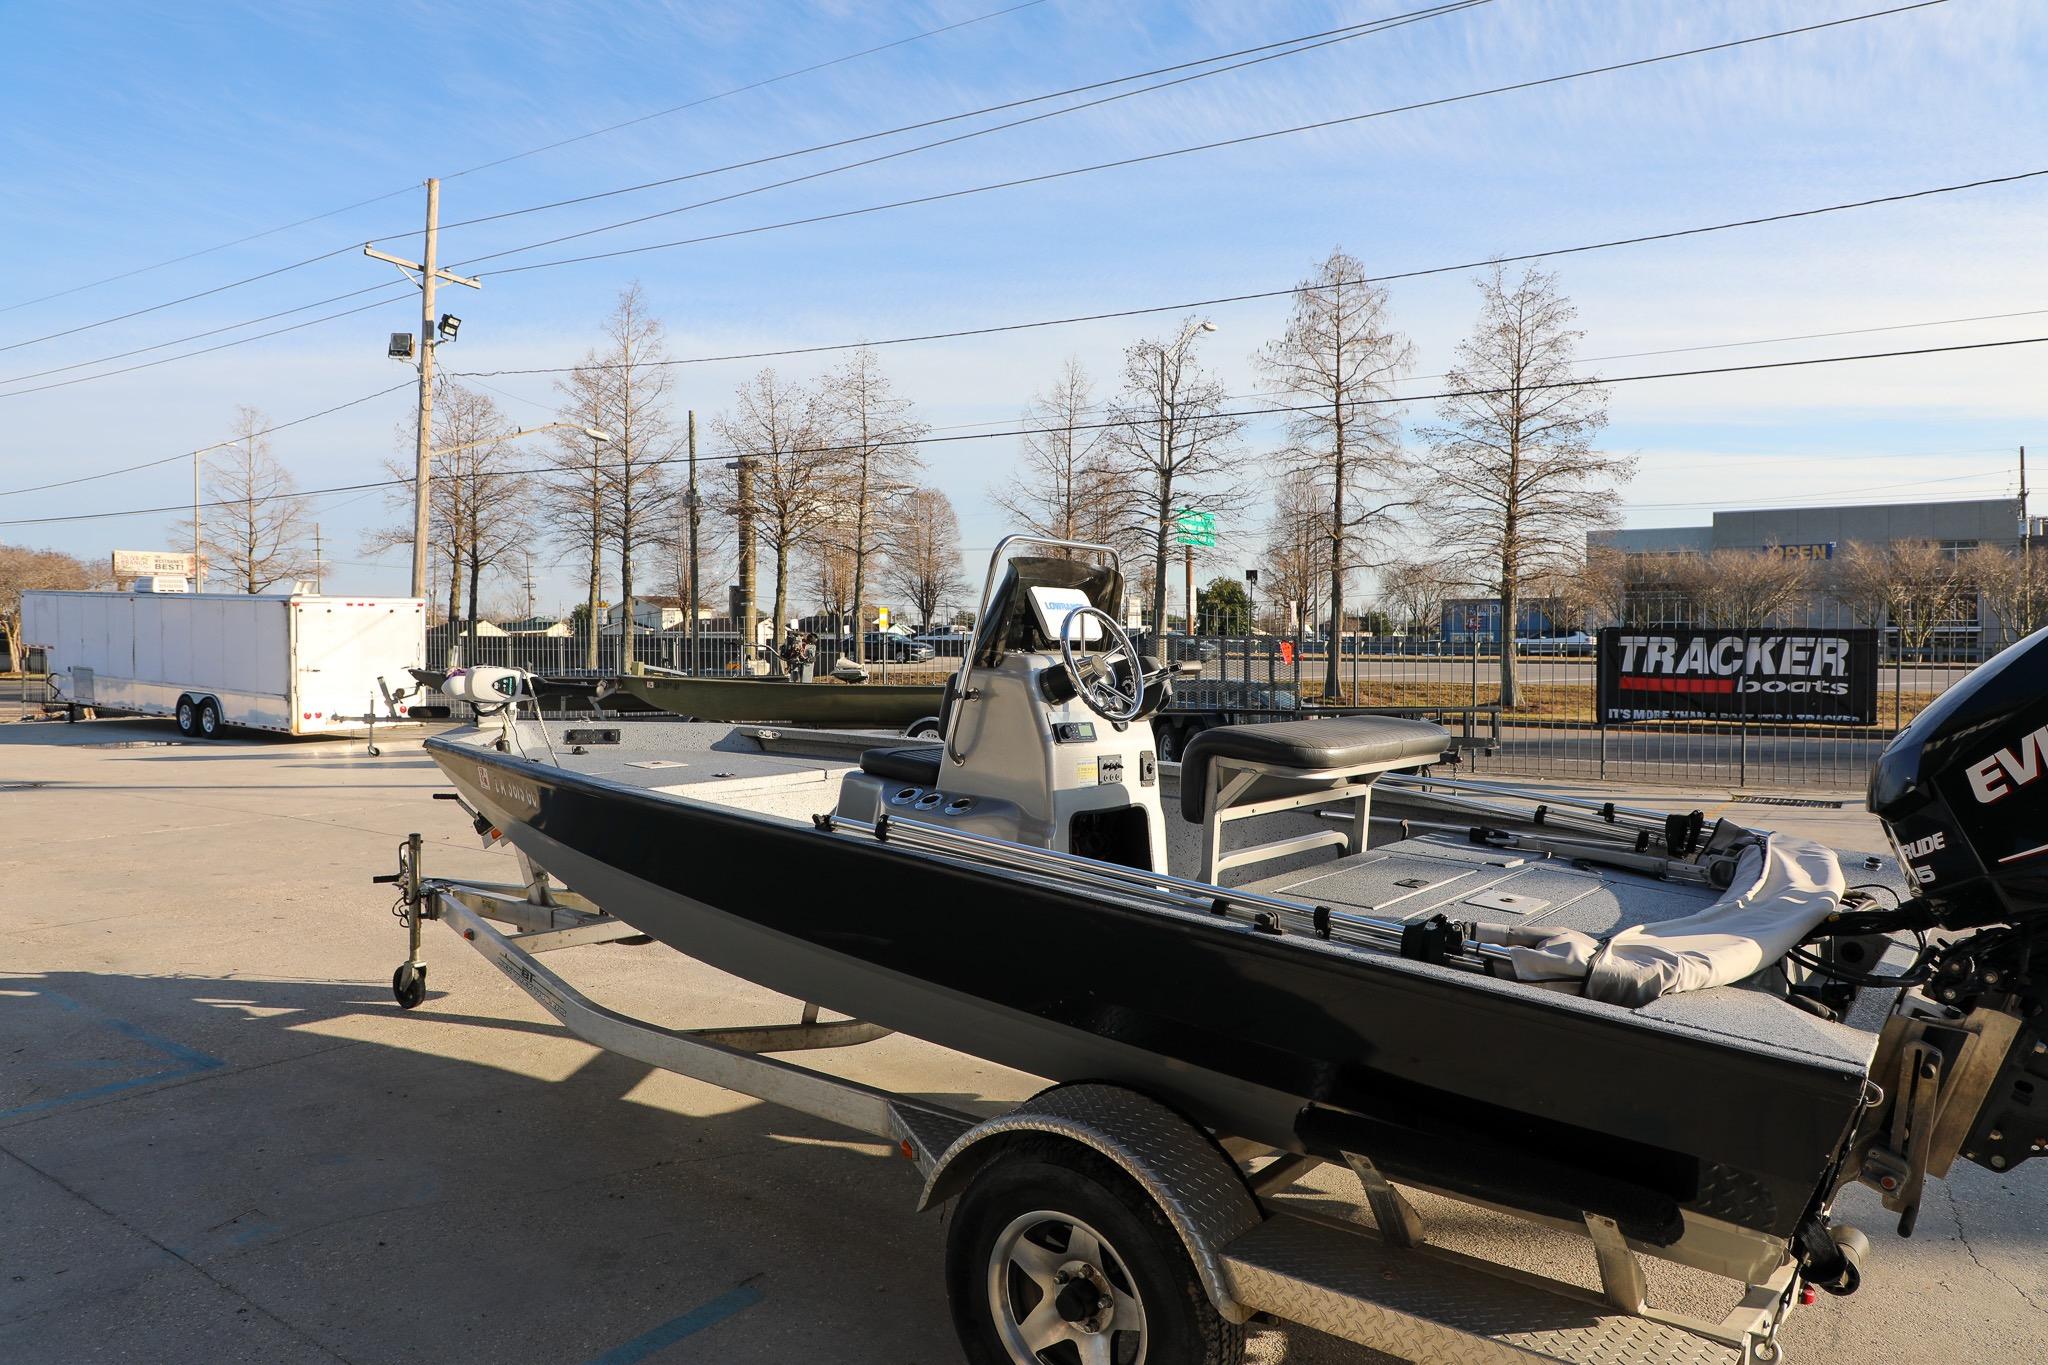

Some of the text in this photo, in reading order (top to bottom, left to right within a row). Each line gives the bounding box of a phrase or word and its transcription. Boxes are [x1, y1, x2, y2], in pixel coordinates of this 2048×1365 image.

[154, 563, 184, 571] BEST!
[1045, 602, 1085, 611] LOWRAN
[1618, 636, 1849, 676] TRACKER
[1737, 676, 1849, 695] boats
[1608, 708, 1631, 719] IT'S
[1633, 709, 1670, 719] MORE
